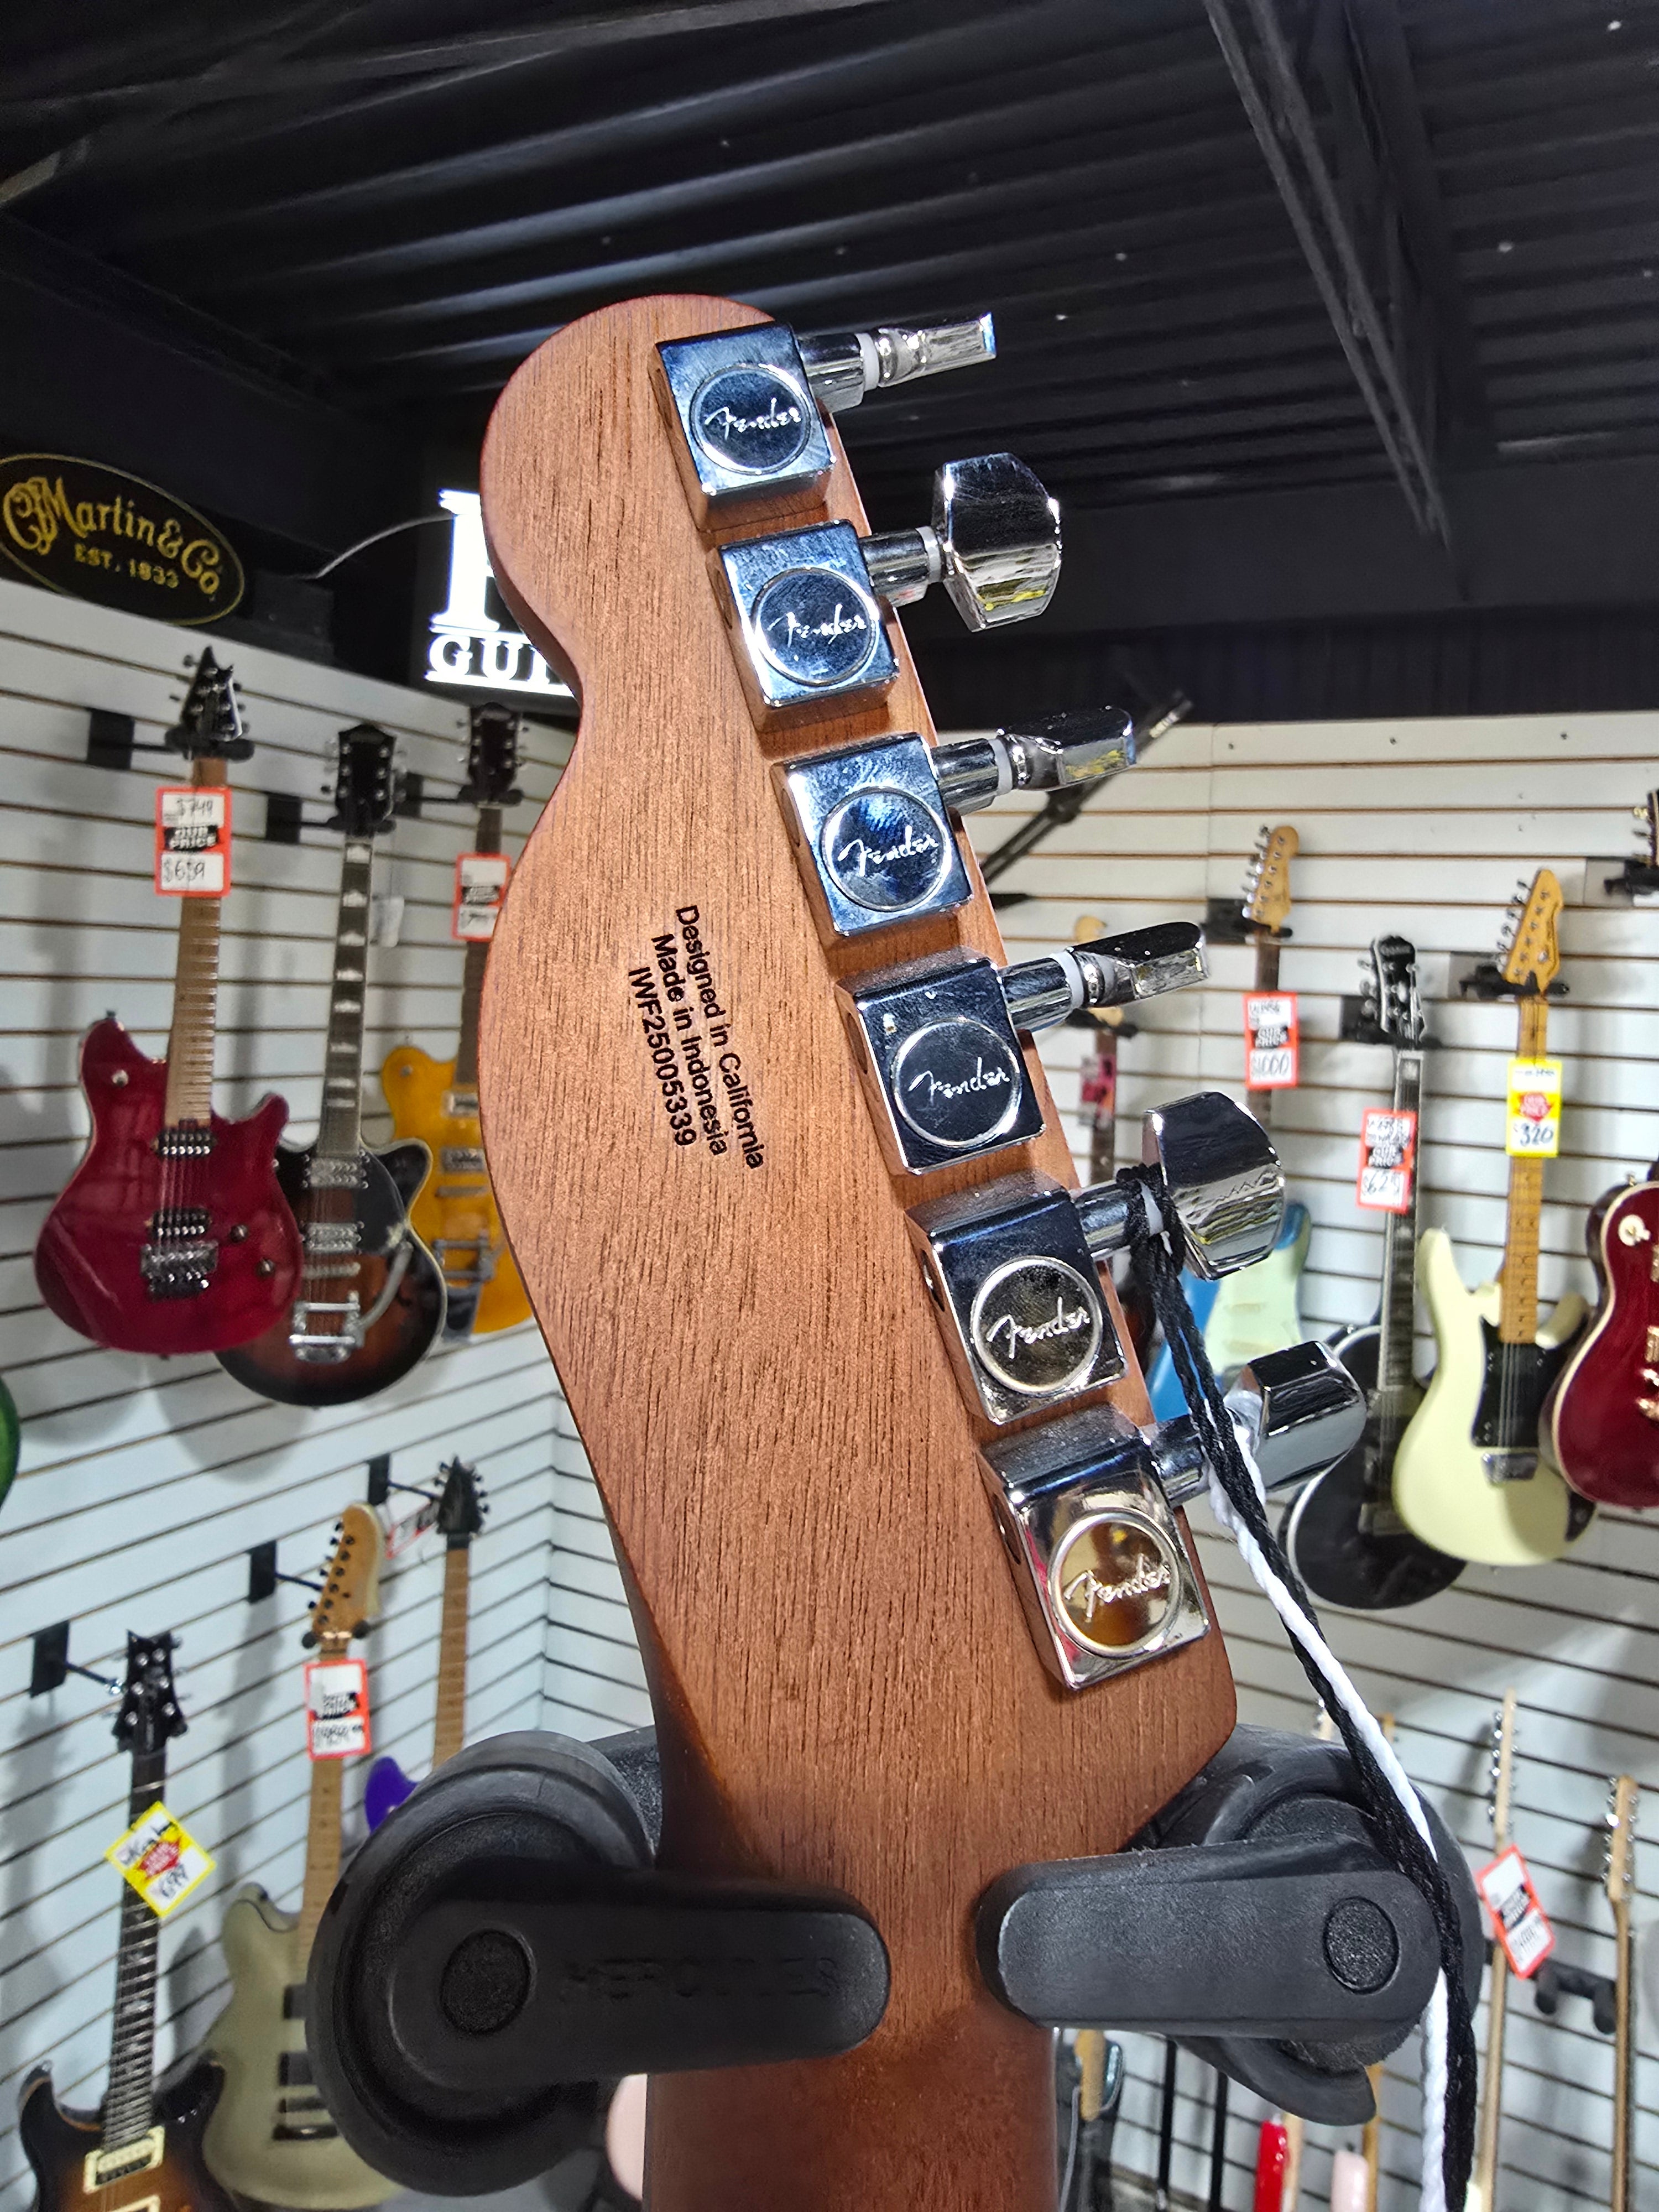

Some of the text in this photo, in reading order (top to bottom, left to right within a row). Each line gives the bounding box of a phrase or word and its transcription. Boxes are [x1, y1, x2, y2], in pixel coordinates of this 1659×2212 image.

[704, 398, 802, 441] Fender
[767, 603, 867, 648] Fender
[838, 825, 940, 877] Fender
[628, 967, 697, 1146] IWF25005339
[651, 933, 729, 1156] Made in Indonesia
[675, 905, 764, 1169] Designed in California
[909, 1056, 1010, 1102] Fender
[987, 1297, 1090, 1359] Fender
[1065, 1554, 1171, 1619] Fender
